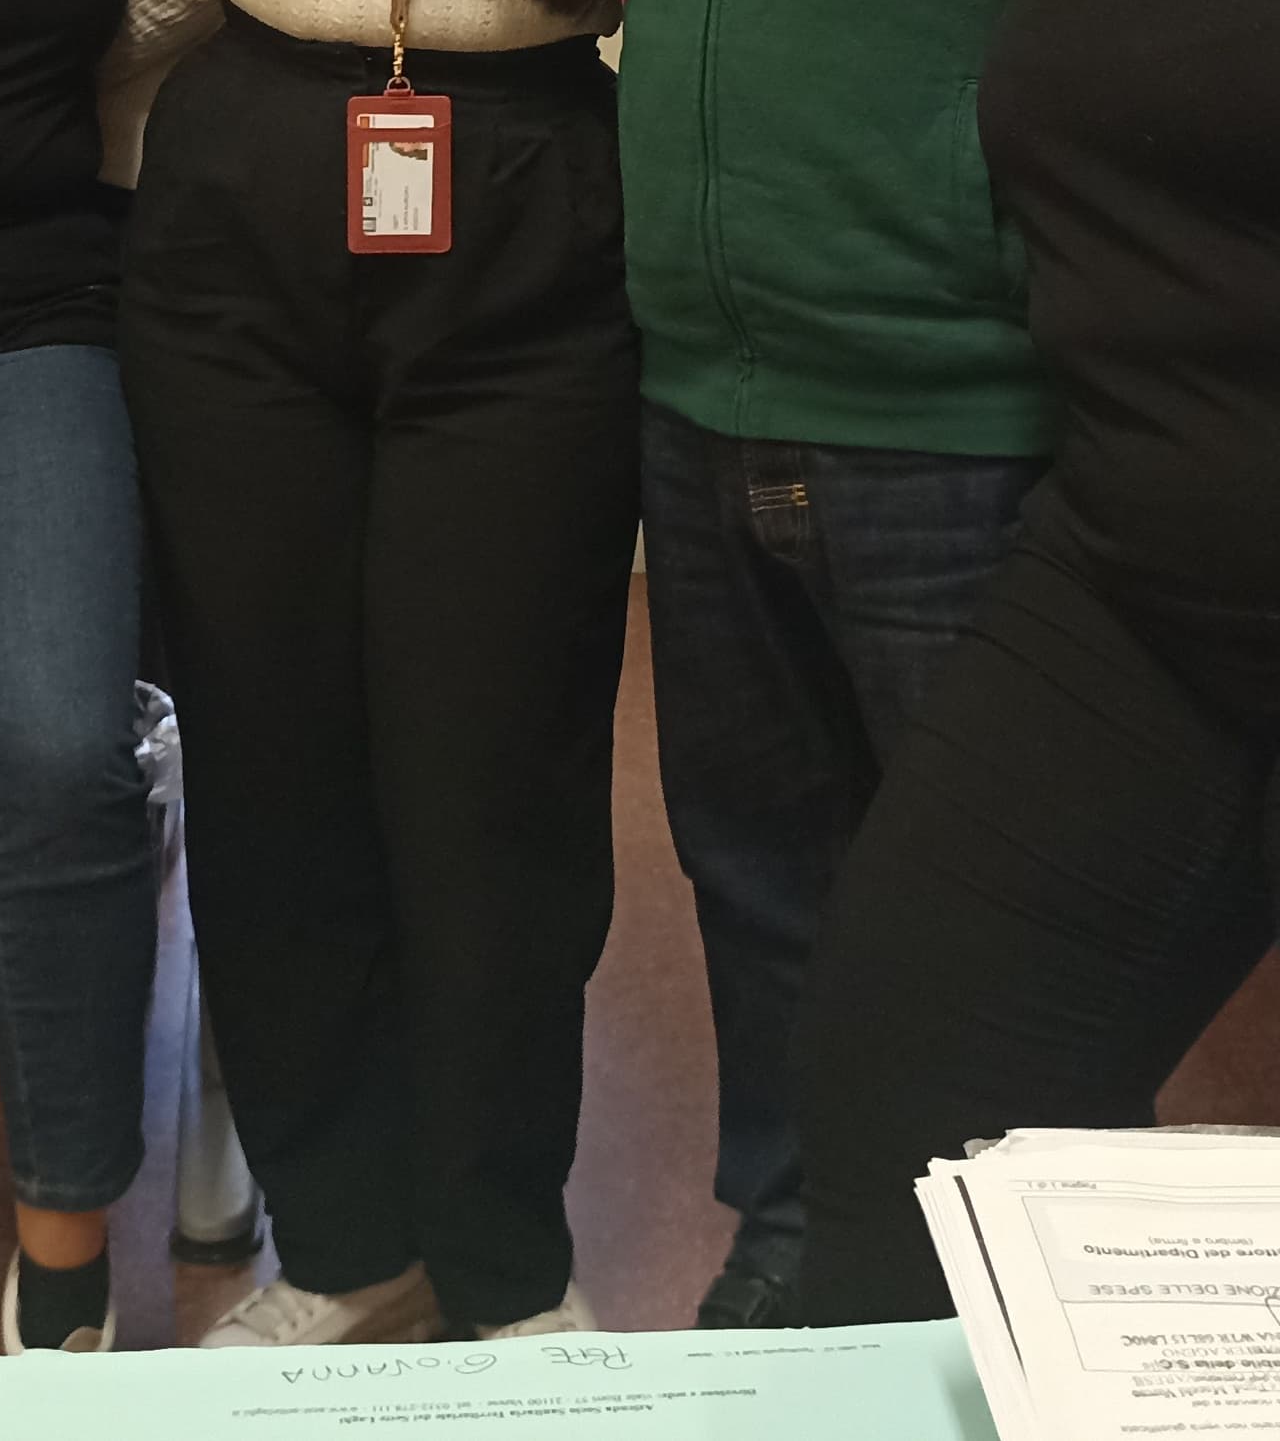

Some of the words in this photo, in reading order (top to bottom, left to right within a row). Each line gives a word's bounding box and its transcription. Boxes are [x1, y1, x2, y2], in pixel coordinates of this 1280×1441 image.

[1082, 1243, 1199, 1260] Dipartimento
[1204, 1248, 1231, 1259] del
[1087, 1283, 1153, 1297] SPESE
[1157, 1283, 1219, 1297] DELLE
[1193, 1359, 1236, 1370] della
[509, 1407, 566, 1417] Sanitaria
[568, 1405, 602, 1415] Socio
[604, 1403, 654, 1414] Azienda
